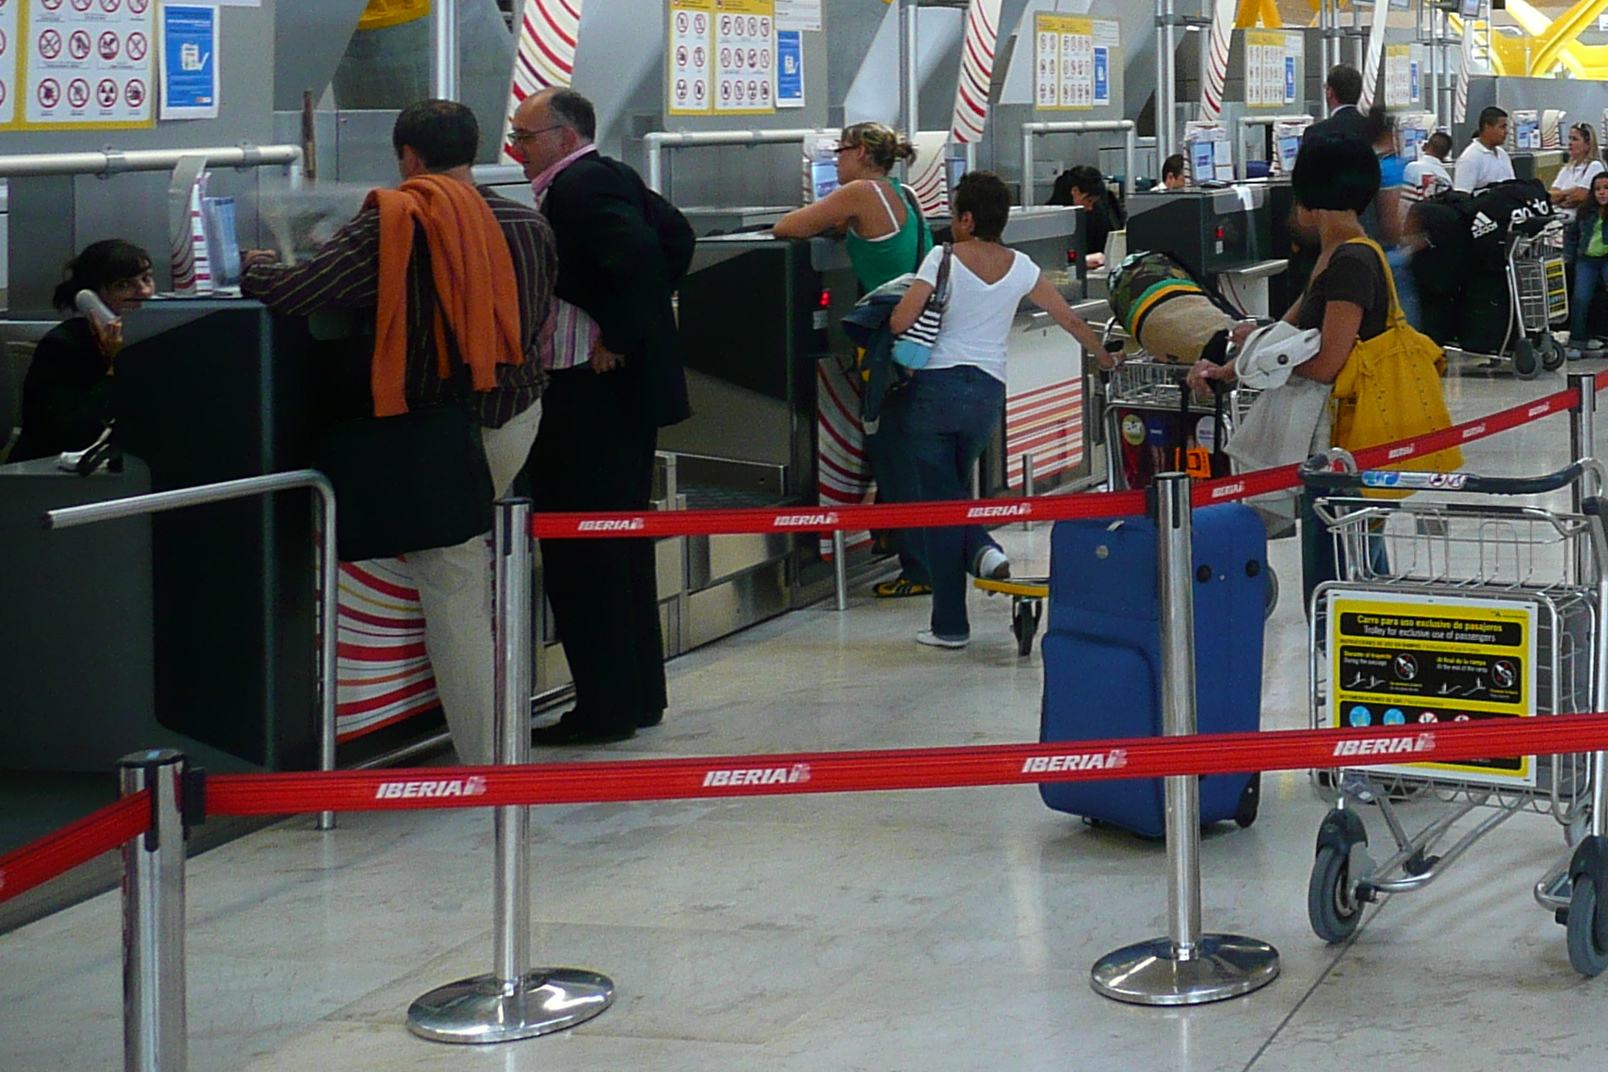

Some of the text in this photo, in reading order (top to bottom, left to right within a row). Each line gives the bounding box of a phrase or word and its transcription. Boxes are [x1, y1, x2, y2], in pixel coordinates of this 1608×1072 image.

[775, 514, 828, 527] IBERIA
[967, 505, 1022, 518] IBERIA
[578, 520, 631, 531] IBERIA
[1357, 614, 1379, 624] Carro
[1381, 617, 1399, 627] para
[1416, 619, 1451, 628] exclusivo
[1453, 621, 1463, 629] de
[1465, 622, 1503, 632] pasajeros
[1363, 624, 1496, 643] Trolley for exclusive use of passengers
[1333, 737, 1416, 756] IBERIA
[1021, 754, 1106, 773] IBERIA
[702, 768, 789, 787] IBERIA
[374, 779, 463, 799] IBERIA
